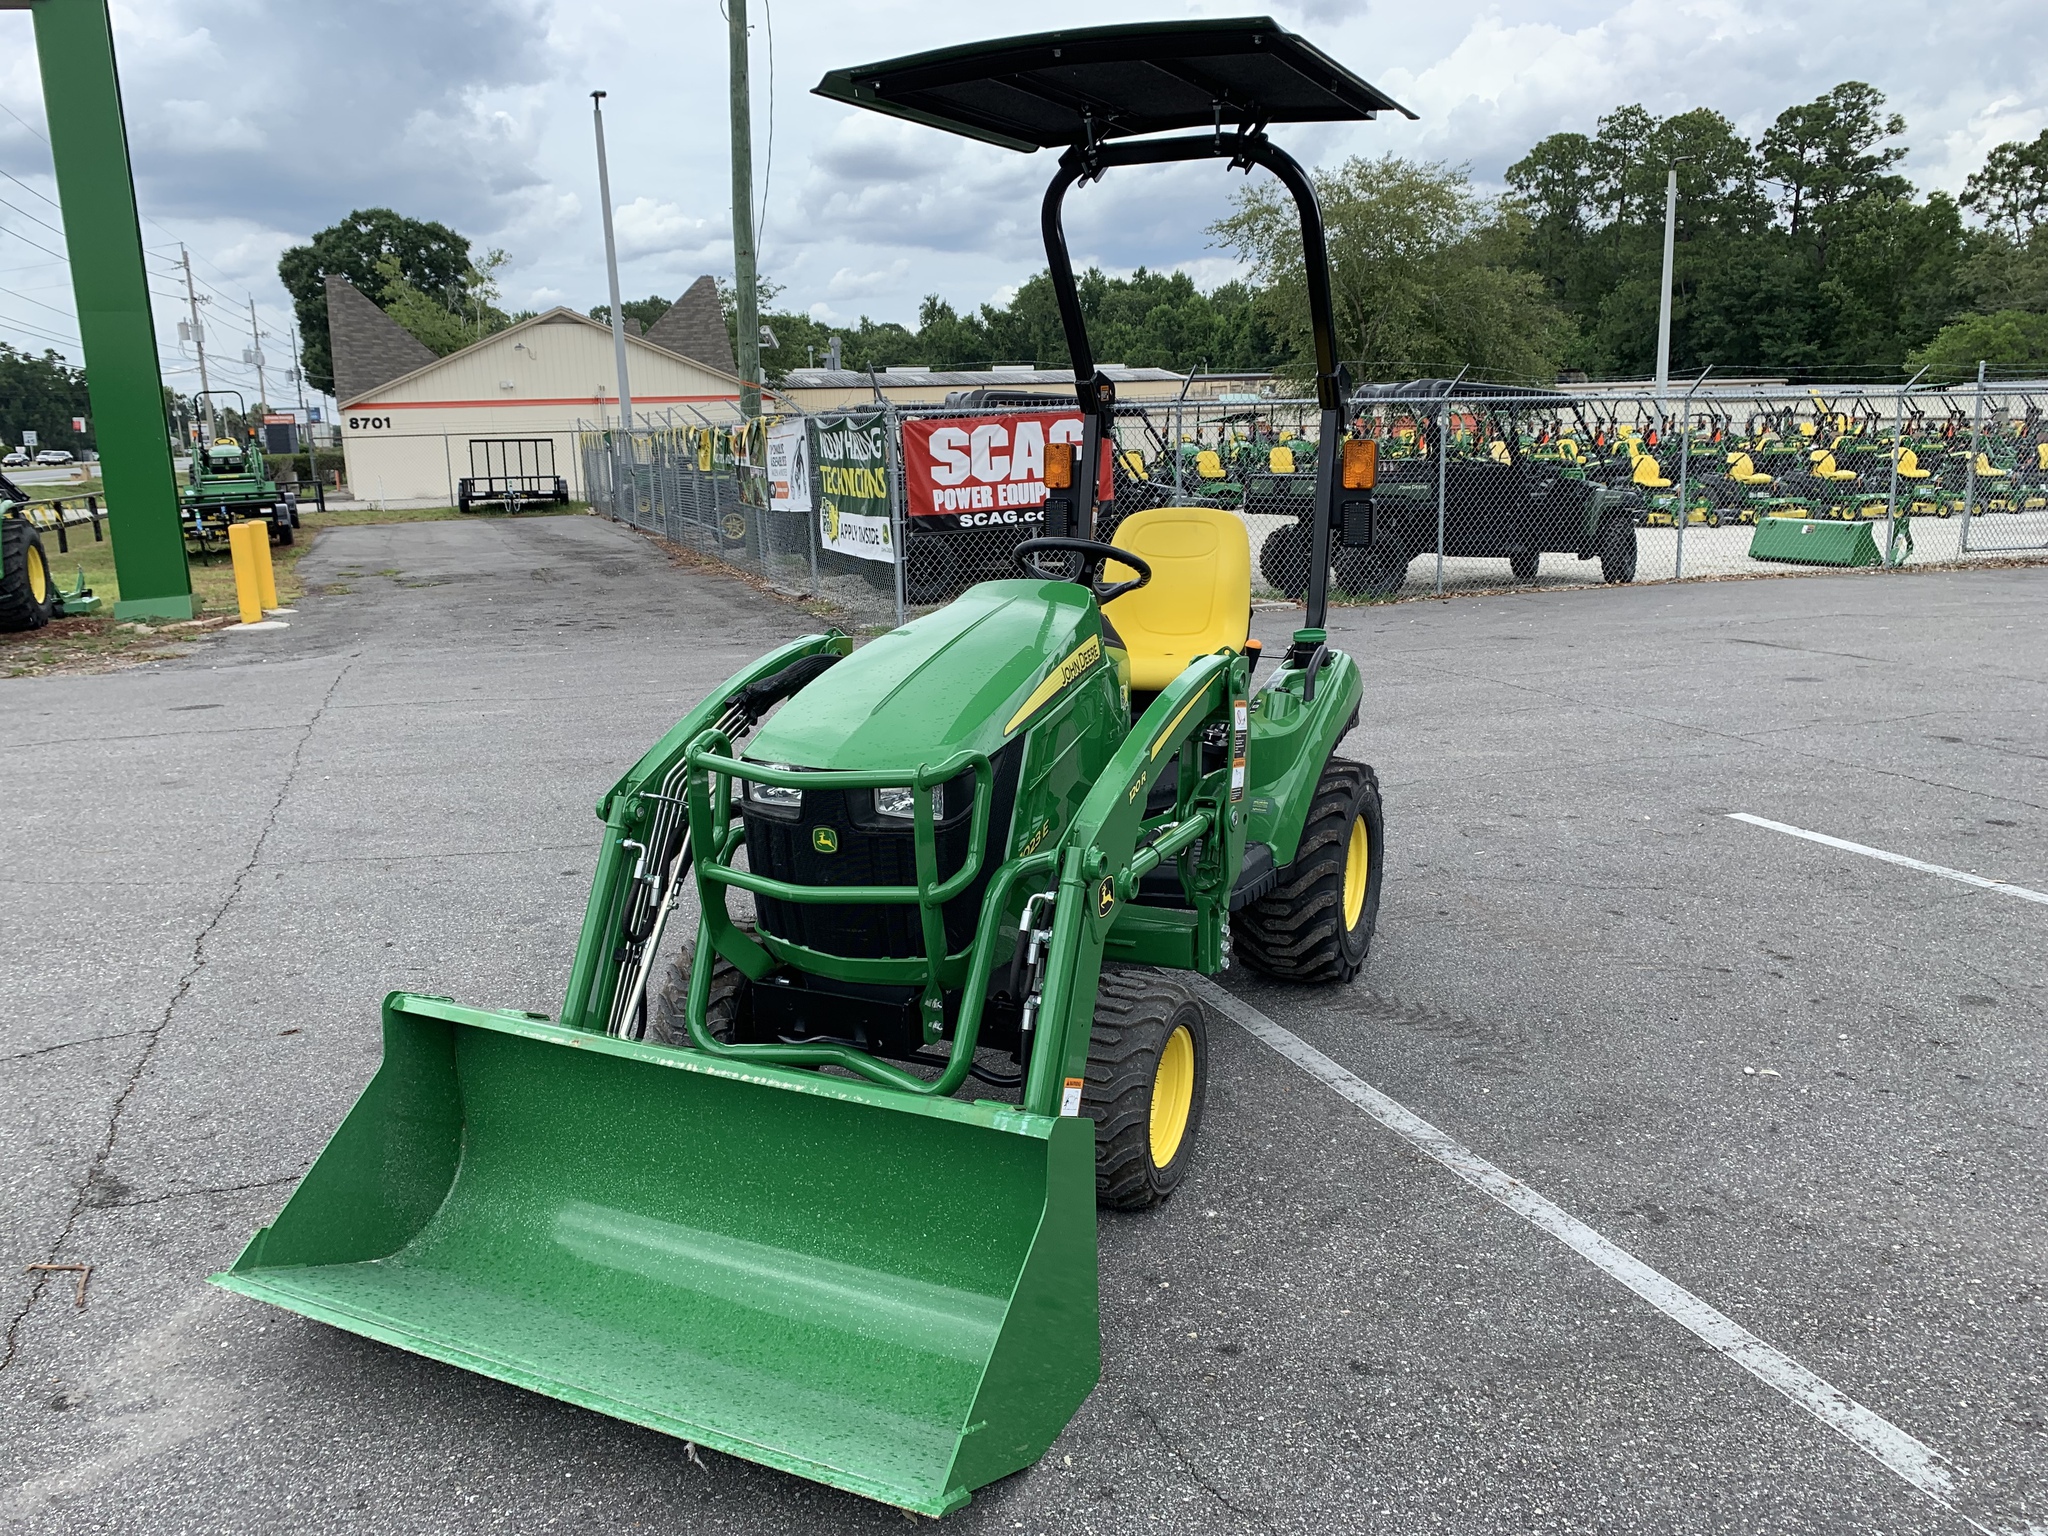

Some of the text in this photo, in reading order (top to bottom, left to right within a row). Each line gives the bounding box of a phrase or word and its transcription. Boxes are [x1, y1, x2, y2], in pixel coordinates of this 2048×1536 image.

[349, 417, 391, 429] 8701
[819, 427, 882, 460] NOW HIRING
[820, 465, 887, 498] TECHNICIANS
[932, 481, 1050, 511] POWER EQUIP
[840, 523, 880, 545] APPLY INSIDE
[1061, 644, 1100, 685] JOHN DEERE
